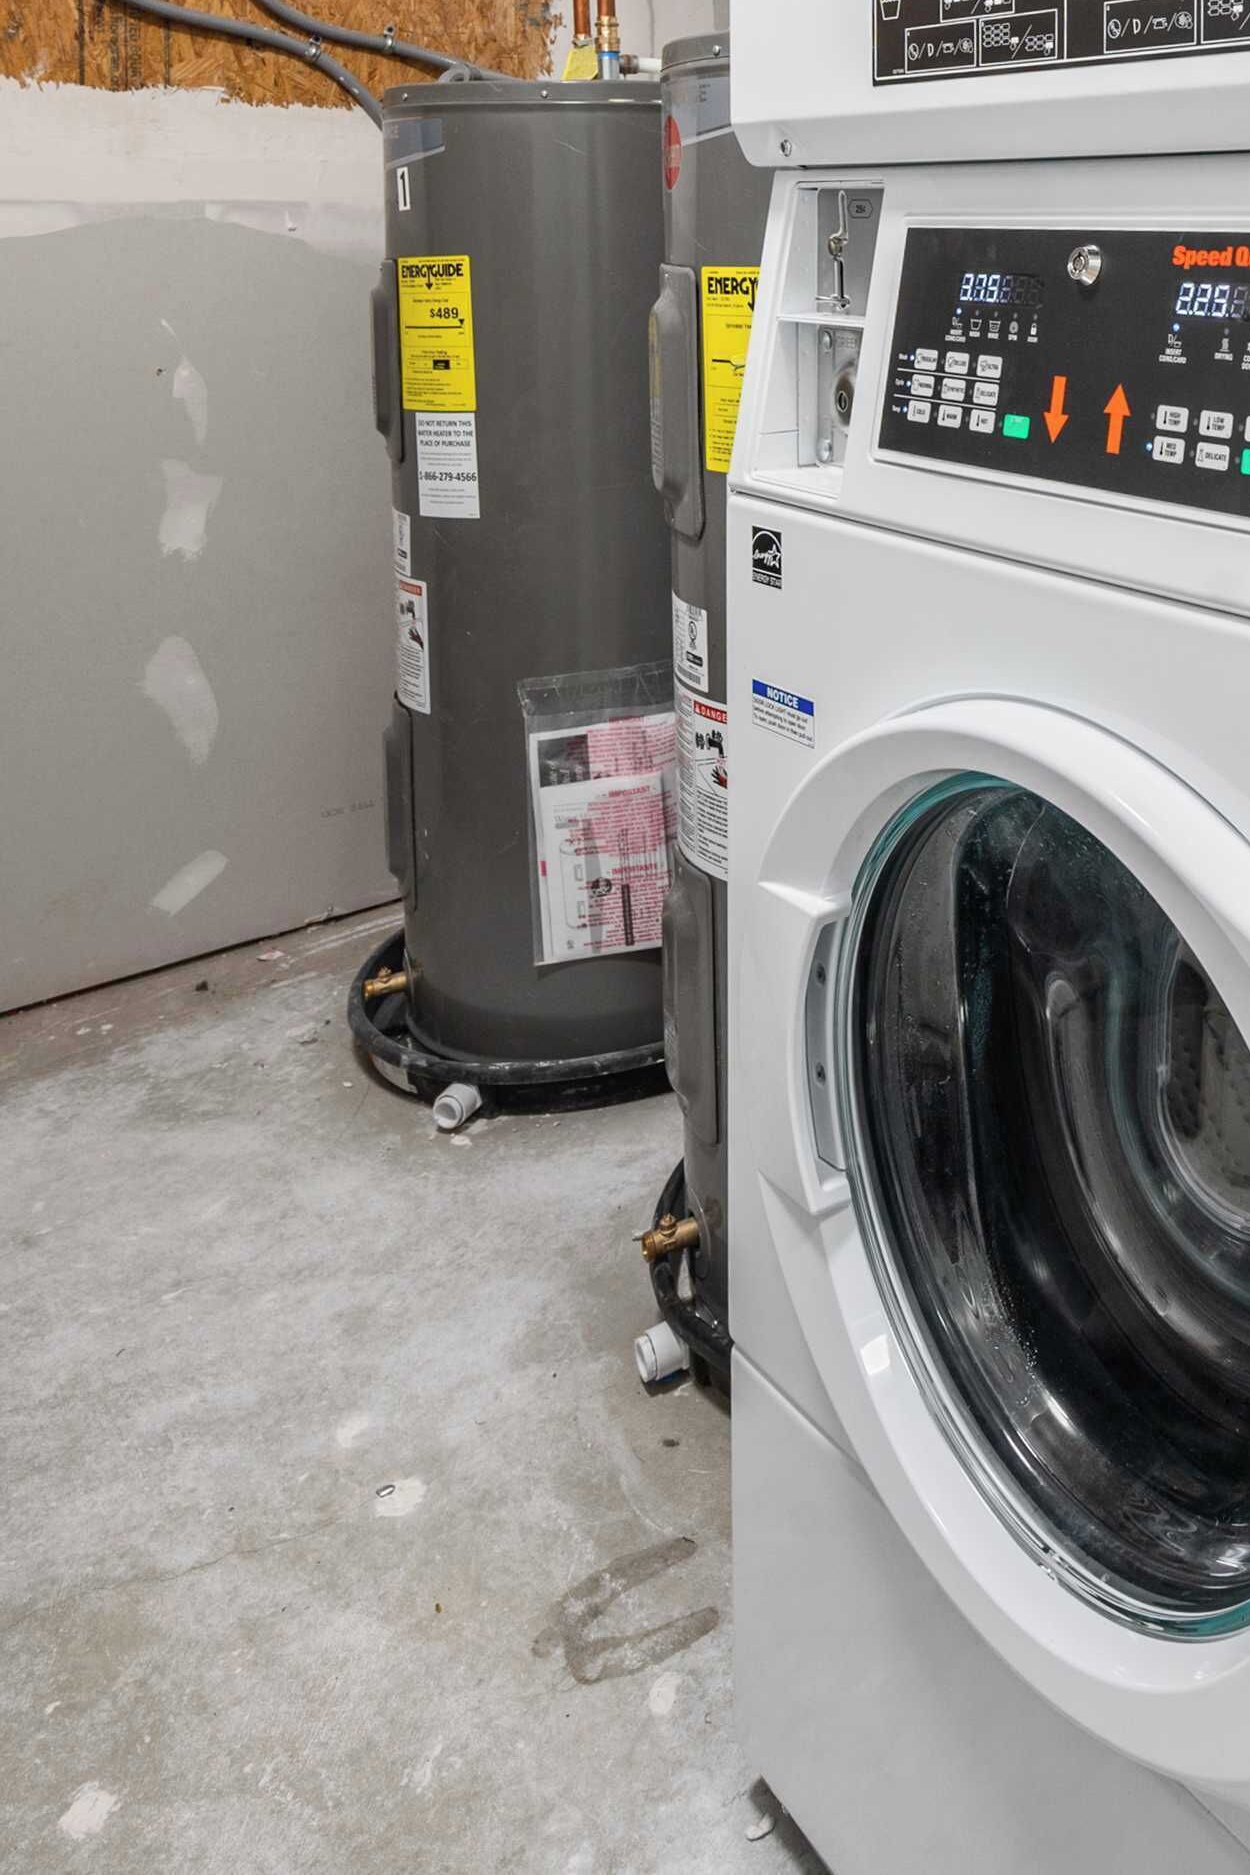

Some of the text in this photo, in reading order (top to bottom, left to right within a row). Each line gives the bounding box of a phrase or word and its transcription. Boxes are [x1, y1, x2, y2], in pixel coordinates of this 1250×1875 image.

[400, 170, 407, 207] 1
[1172, 245, 1233, 270] Speed
[430, 307, 459, 320] $489
[1213, 416, 1224, 424] LOW
[1204, 452, 1227, 462] DELICATE
[766, 686, 799, 708] NOTICE
[702, 706, 728, 723] DANGE
